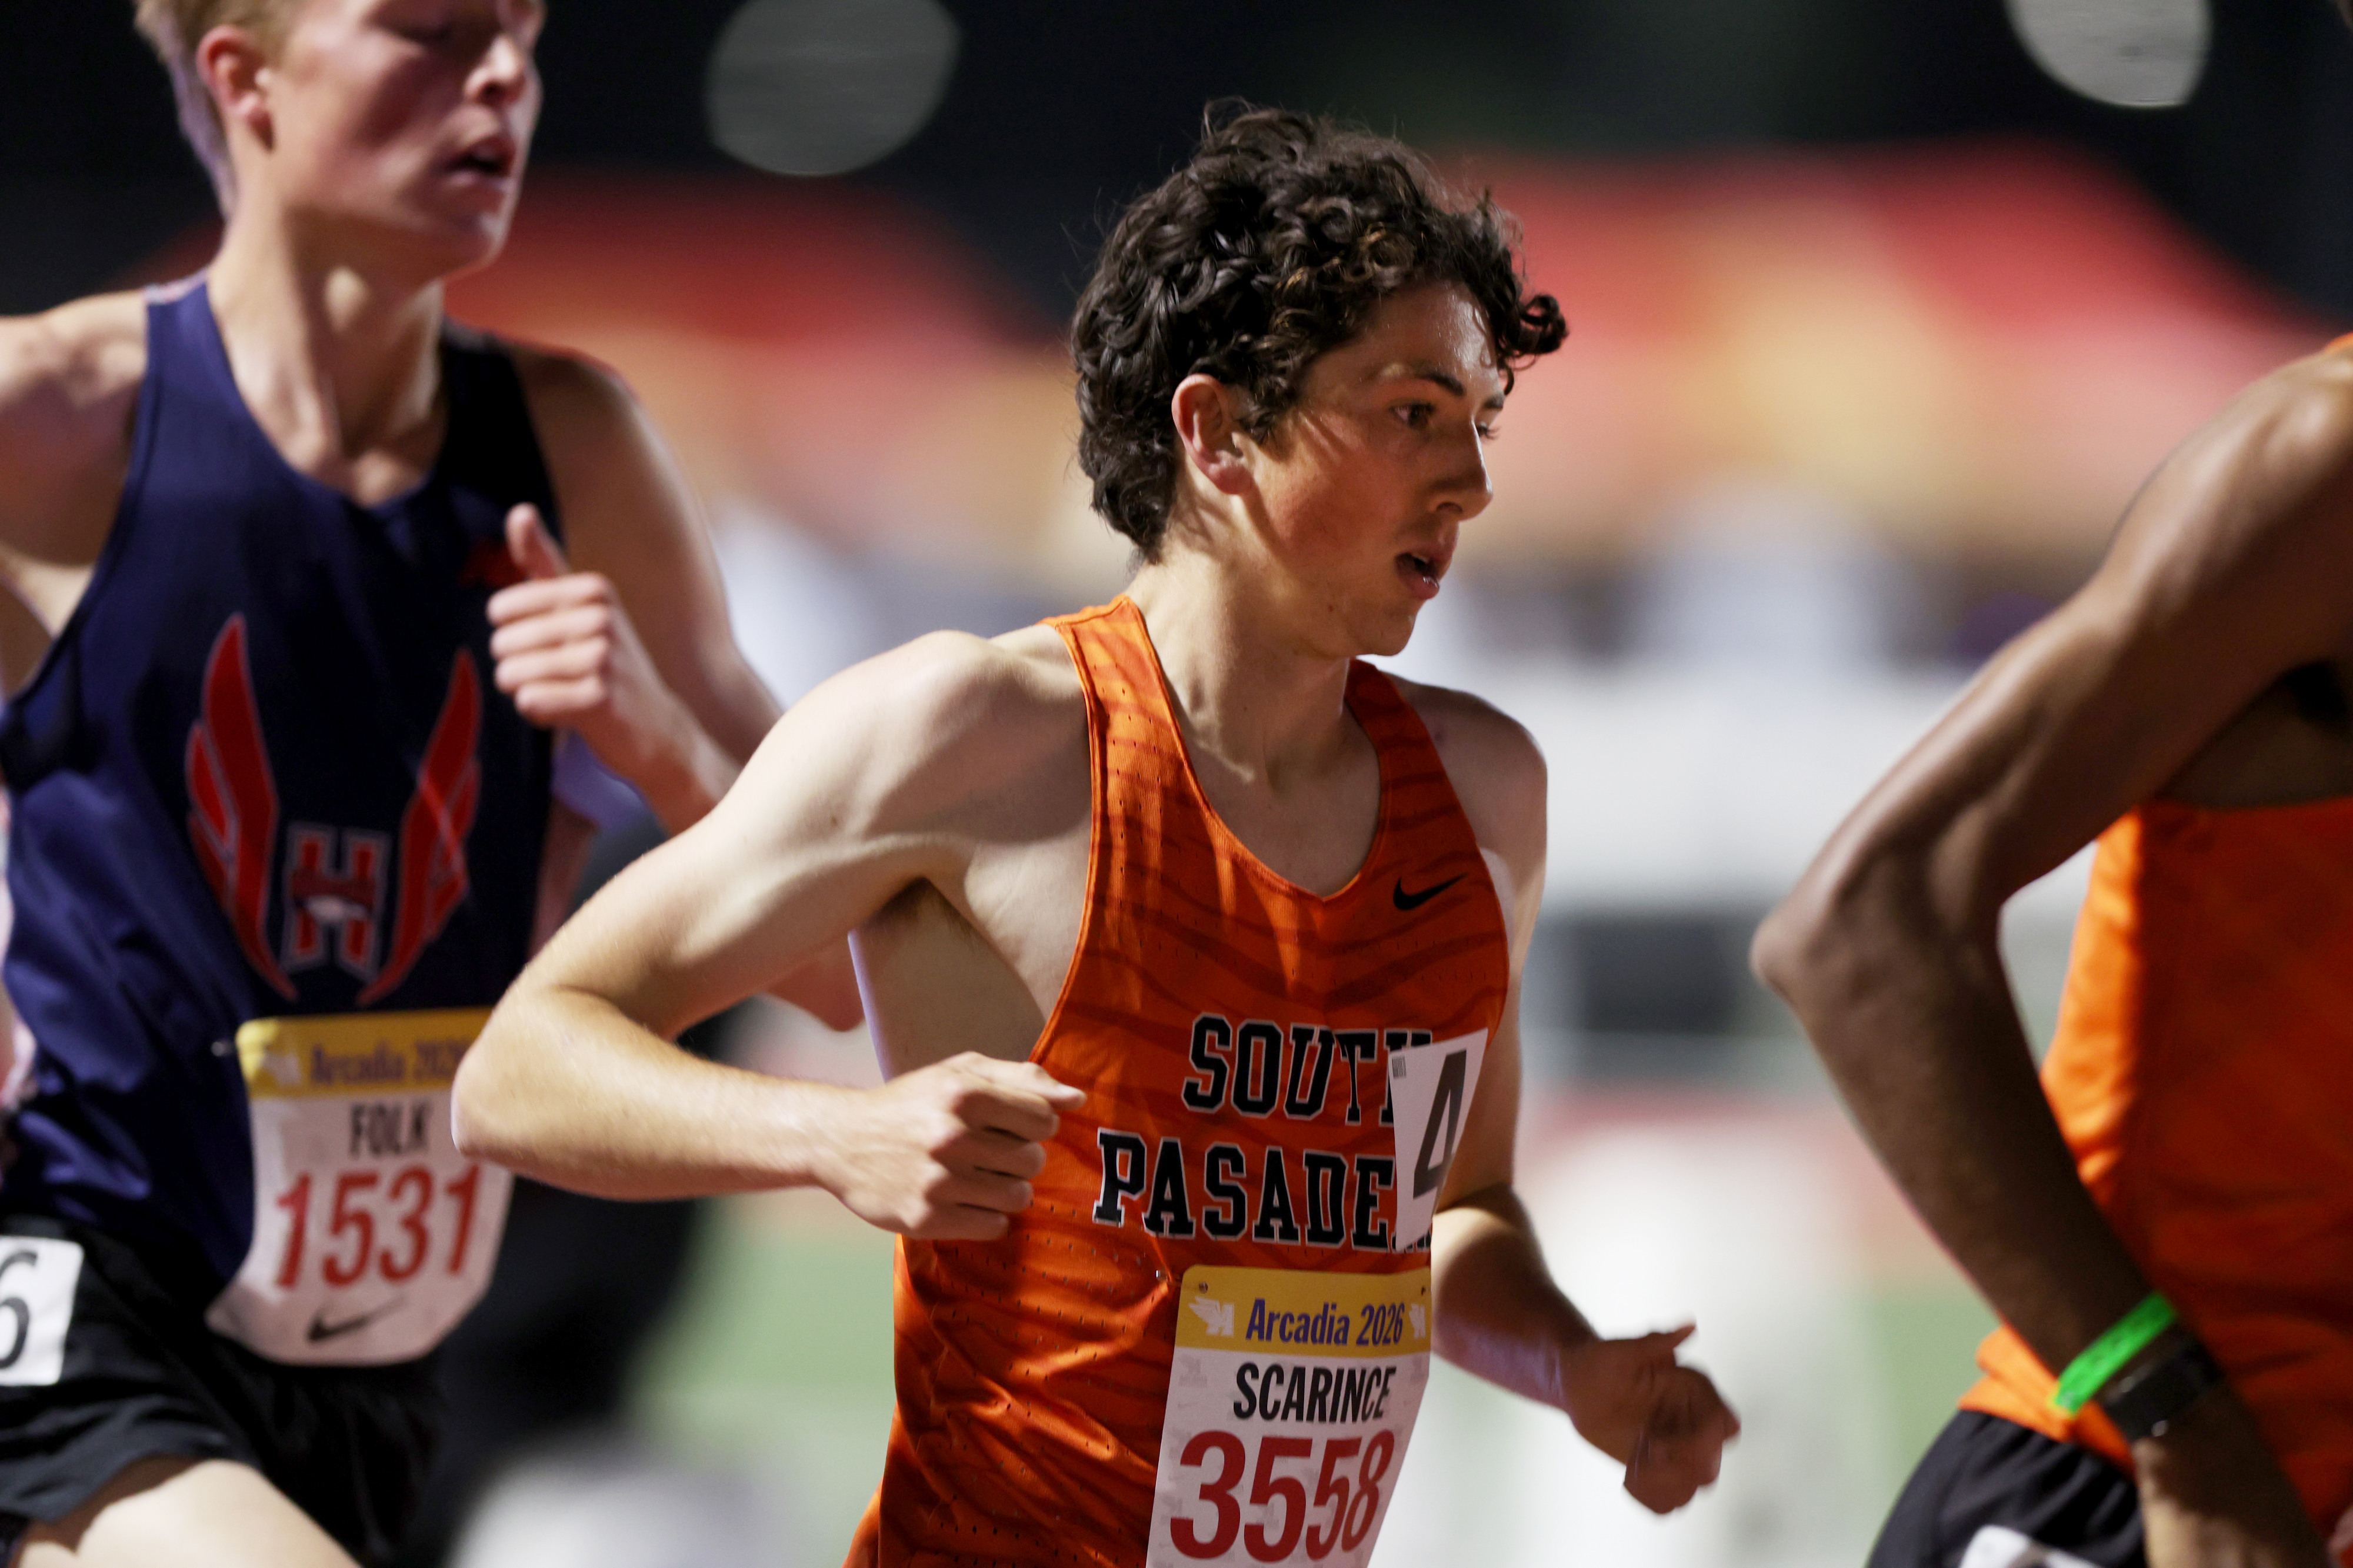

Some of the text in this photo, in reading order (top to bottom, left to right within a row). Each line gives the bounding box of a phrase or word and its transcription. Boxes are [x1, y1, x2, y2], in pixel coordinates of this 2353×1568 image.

[349, 1100, 433, 1159] FOLK
[1412, 1049, 1467, 1200] 4
[275, 1163, 482, 1290] 1531
[1092, 1127, 1432, 1253] PASADE
[1245, 1297, 1405, 1346] Arcadia 2026
[1233, 1362, 1397, 1424] SCARINCE
[1170, 1429, 1395, 1563] 3558
